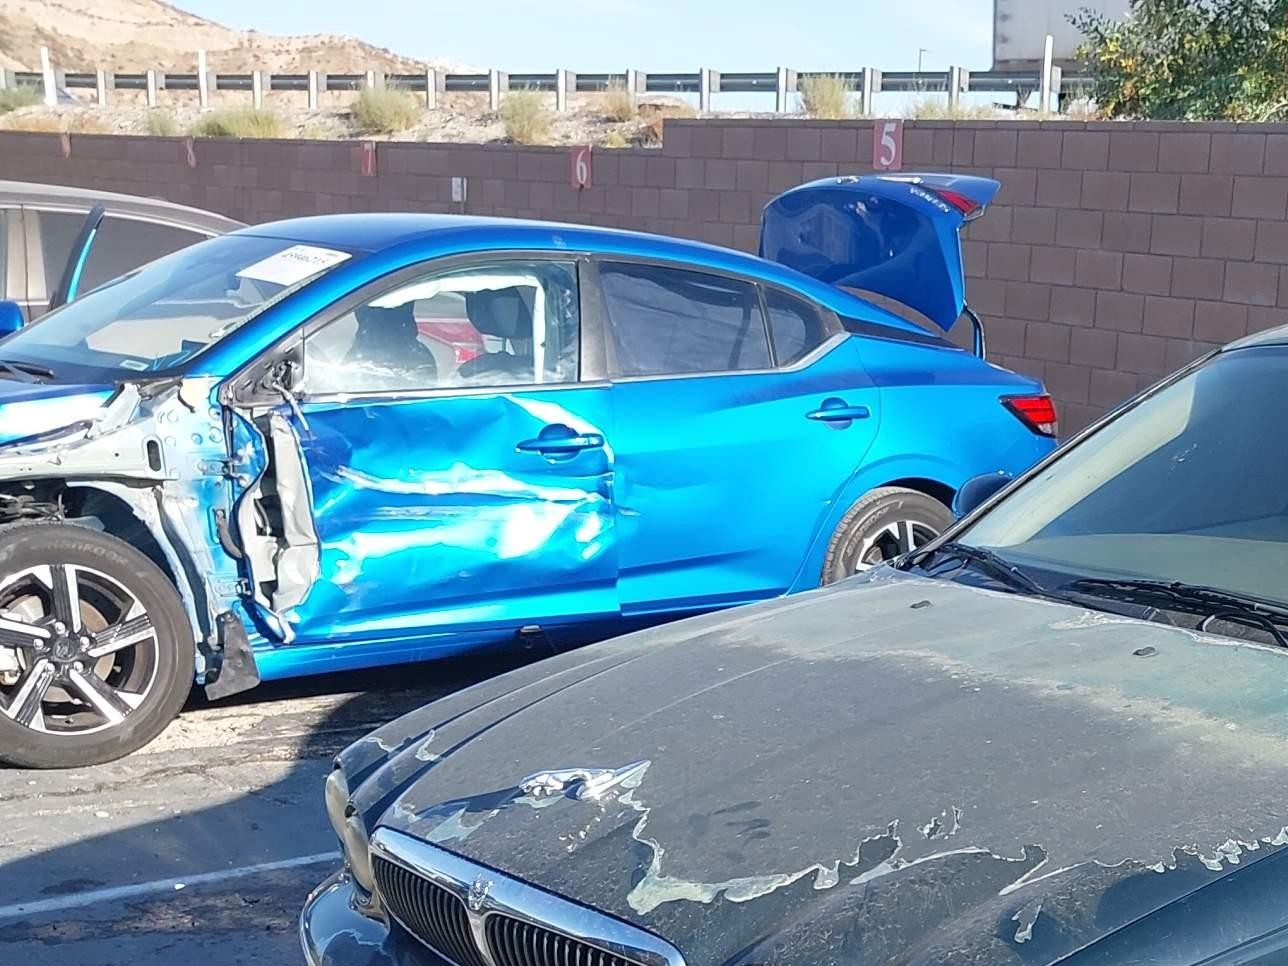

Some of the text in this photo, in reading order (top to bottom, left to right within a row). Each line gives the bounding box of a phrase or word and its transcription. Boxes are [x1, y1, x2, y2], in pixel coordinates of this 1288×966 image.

[186, 136, 196, 168] 8
[363, 142, 373, 173] 7
[880, 122, 896, 166] 5
[576, 149, 587, 184] 6
